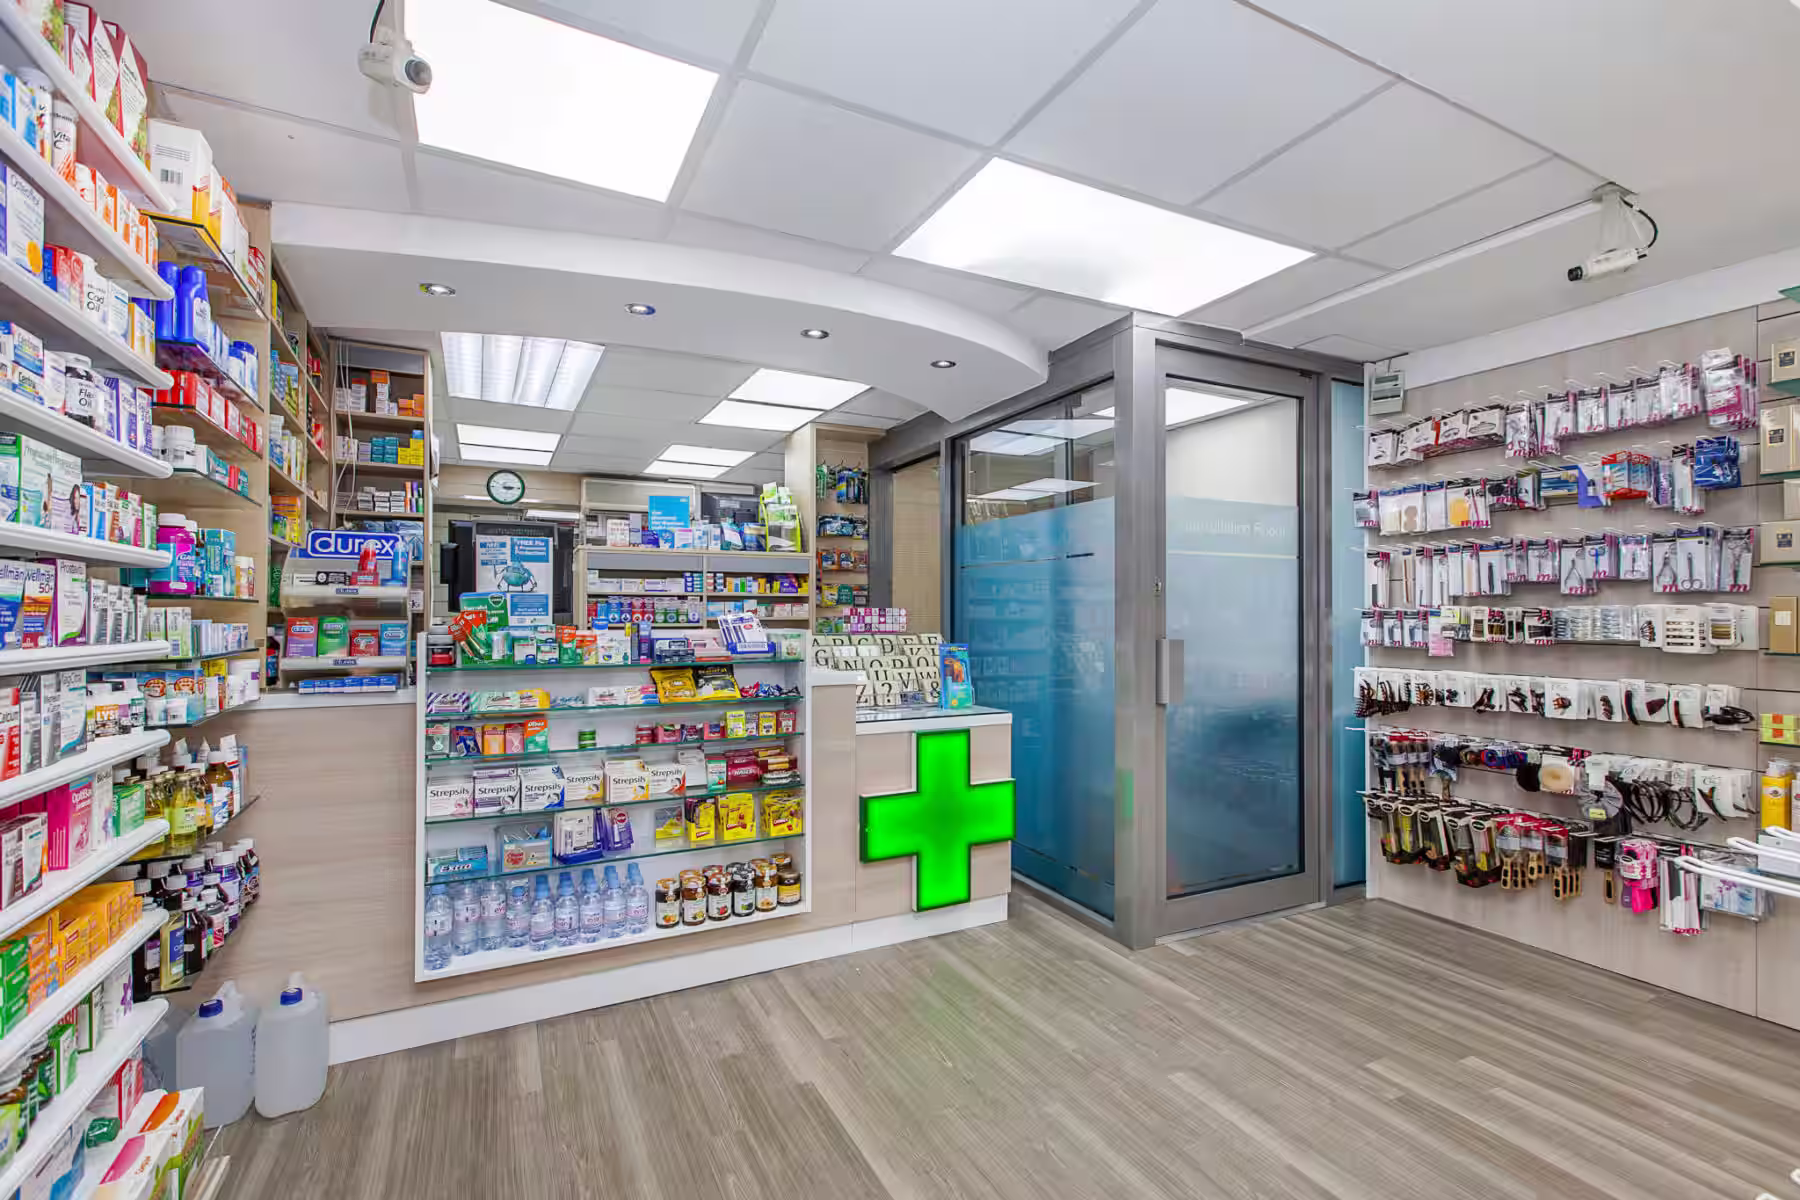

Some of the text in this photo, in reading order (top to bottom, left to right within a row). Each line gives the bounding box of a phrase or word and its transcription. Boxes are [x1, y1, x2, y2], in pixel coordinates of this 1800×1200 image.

[314, 532, 395, 554] durex
[0, 565, 25, 582] ellman
[879, 637, 894, 655] D
[815, 649, 829, 667] G
[899, 671, 911, 689] V
[856, 684, 869, 704] Z
[881, 682, 892, 703] ?
[566, 774, 600, 784] Strepsils
[651, 767, 683, 777] Strepsils
[524, 783, 562, 793] Strepsils
[612, 776, 646, 786] Strepsils
[429, 788, 470, 798] Strepsils
[477, 786, 516, 796] Strepsils
